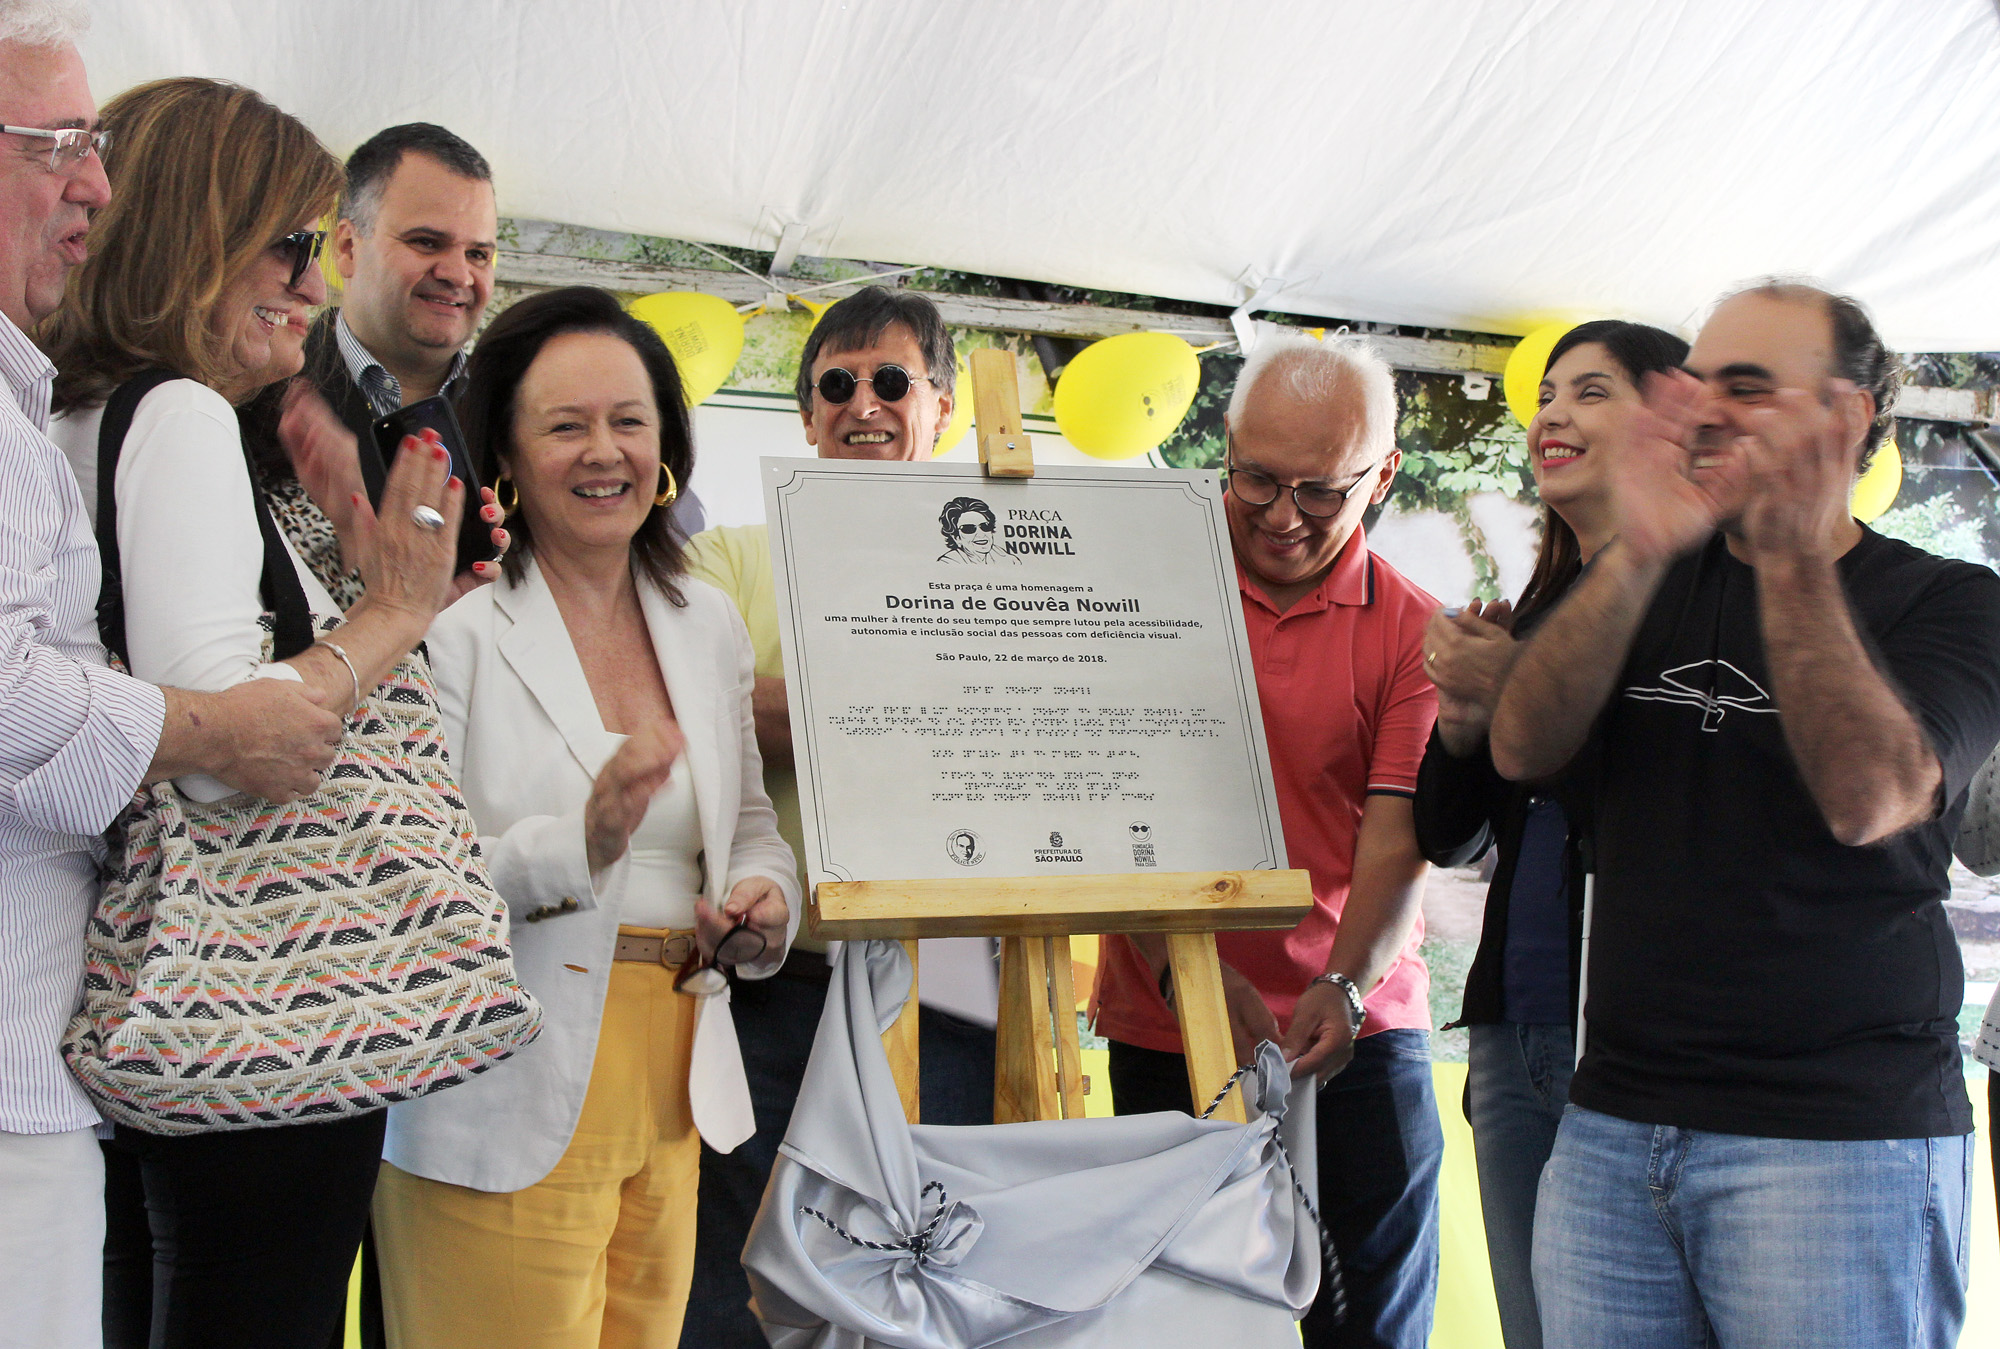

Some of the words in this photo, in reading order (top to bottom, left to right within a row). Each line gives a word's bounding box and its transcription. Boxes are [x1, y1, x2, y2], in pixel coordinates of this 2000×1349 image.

[1007, 508, 1063, 524] PRAÇA
[1003, 524, 1073, 540] DORINA
[1005, 540, 1076, 556] NOWILL
[928, 581, 951, 590] Esta
[953, 583, 983, 592] praça
[985, 581, 993, 591] é
[995, 584, 1018, 592] uma
[1020, 583, 1085, 594] homenagem
[885, 594, 955, 610] Dorina
[961, 595, 987, 611] de
[992, 596, 1070, 612] Gouvêa
[1076, 598, 1141, 613] Nowill
[824, 615, 848, 623] uma
[850, 614, 889, 623] mulher
[891, 614, 899, 624] à
[900, 615, 934, 624] frente
[936, 616, 950, 625] do
[952, 617, 972, 625] seu
[973, 617, 1008, 627] tempo
[1010, 618, 1030, 627] que
[1032, 619, 1072, 628] sempre
[1073, 618, 1101, 627] lutou
[1103, 618, 1126, 628] pela
[1128, 619, 1203, 629] acessibilidade,
[850, 627, 908, 636] autonomia
[919, 627, 964, 637] inclusão
[966, 628, 997, 637] social
[999, 629, 1019, 638] das
[1021, 630, 1064, 639] pessoas
[1065, 631, 1088, 639] com
[1090, 630, 1146, 640] deficiência
[1147, 630, 1183, 640] visual.
[935, 652, 956, 662] São
[958, 653, 992, 663] Paulo,
[994, 653, 1009, 662] 22
[1010, 653, 1024, 662] de
[1026, 654, 1060, 664] março
[1061, 654, 1075, 663] de
[1077, 654, 1108, 663] 2018.
[1034, 854, 1054, 863] SÃO
[1054, 855, 1084, 863] PAULO
[1132, 849, 1156, 857] DORINA
